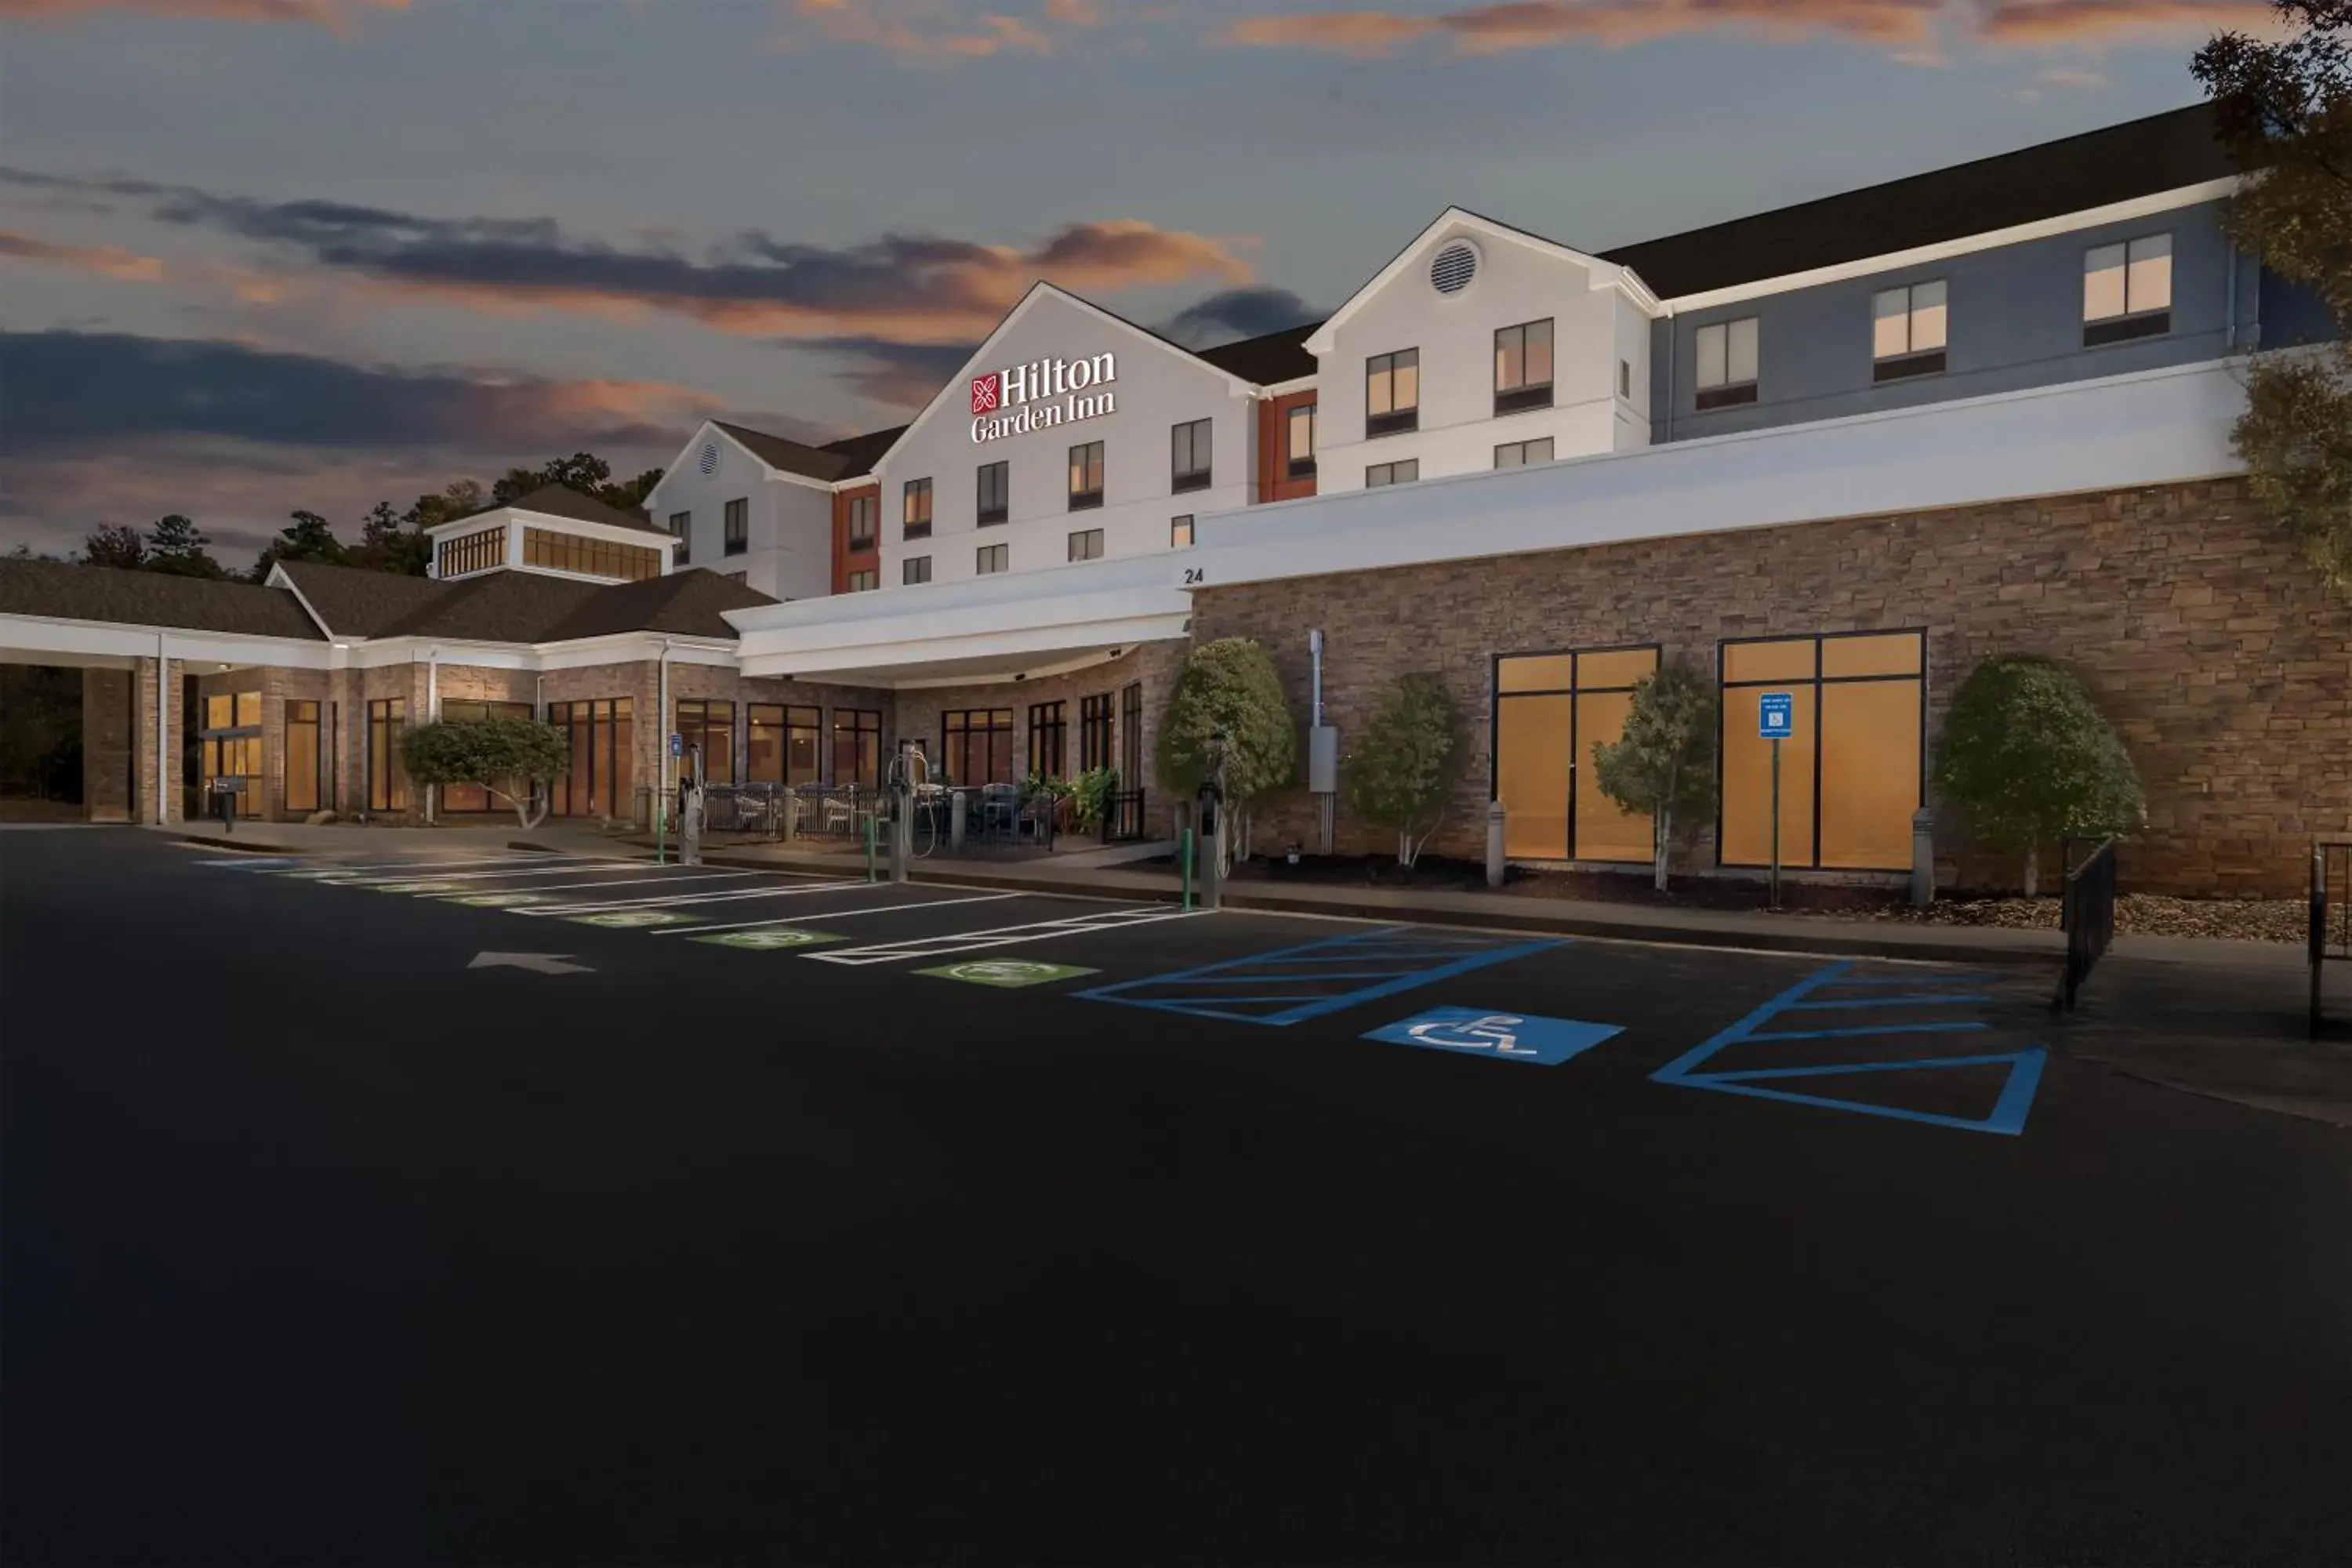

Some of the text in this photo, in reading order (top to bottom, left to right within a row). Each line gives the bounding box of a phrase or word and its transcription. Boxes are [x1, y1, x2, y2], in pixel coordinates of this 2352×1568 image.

[1000, 352, 1116, 407] Hilton
[971, 392, 1116, 443] Garden Inn
[1185, 568, 1203, 584] 24
